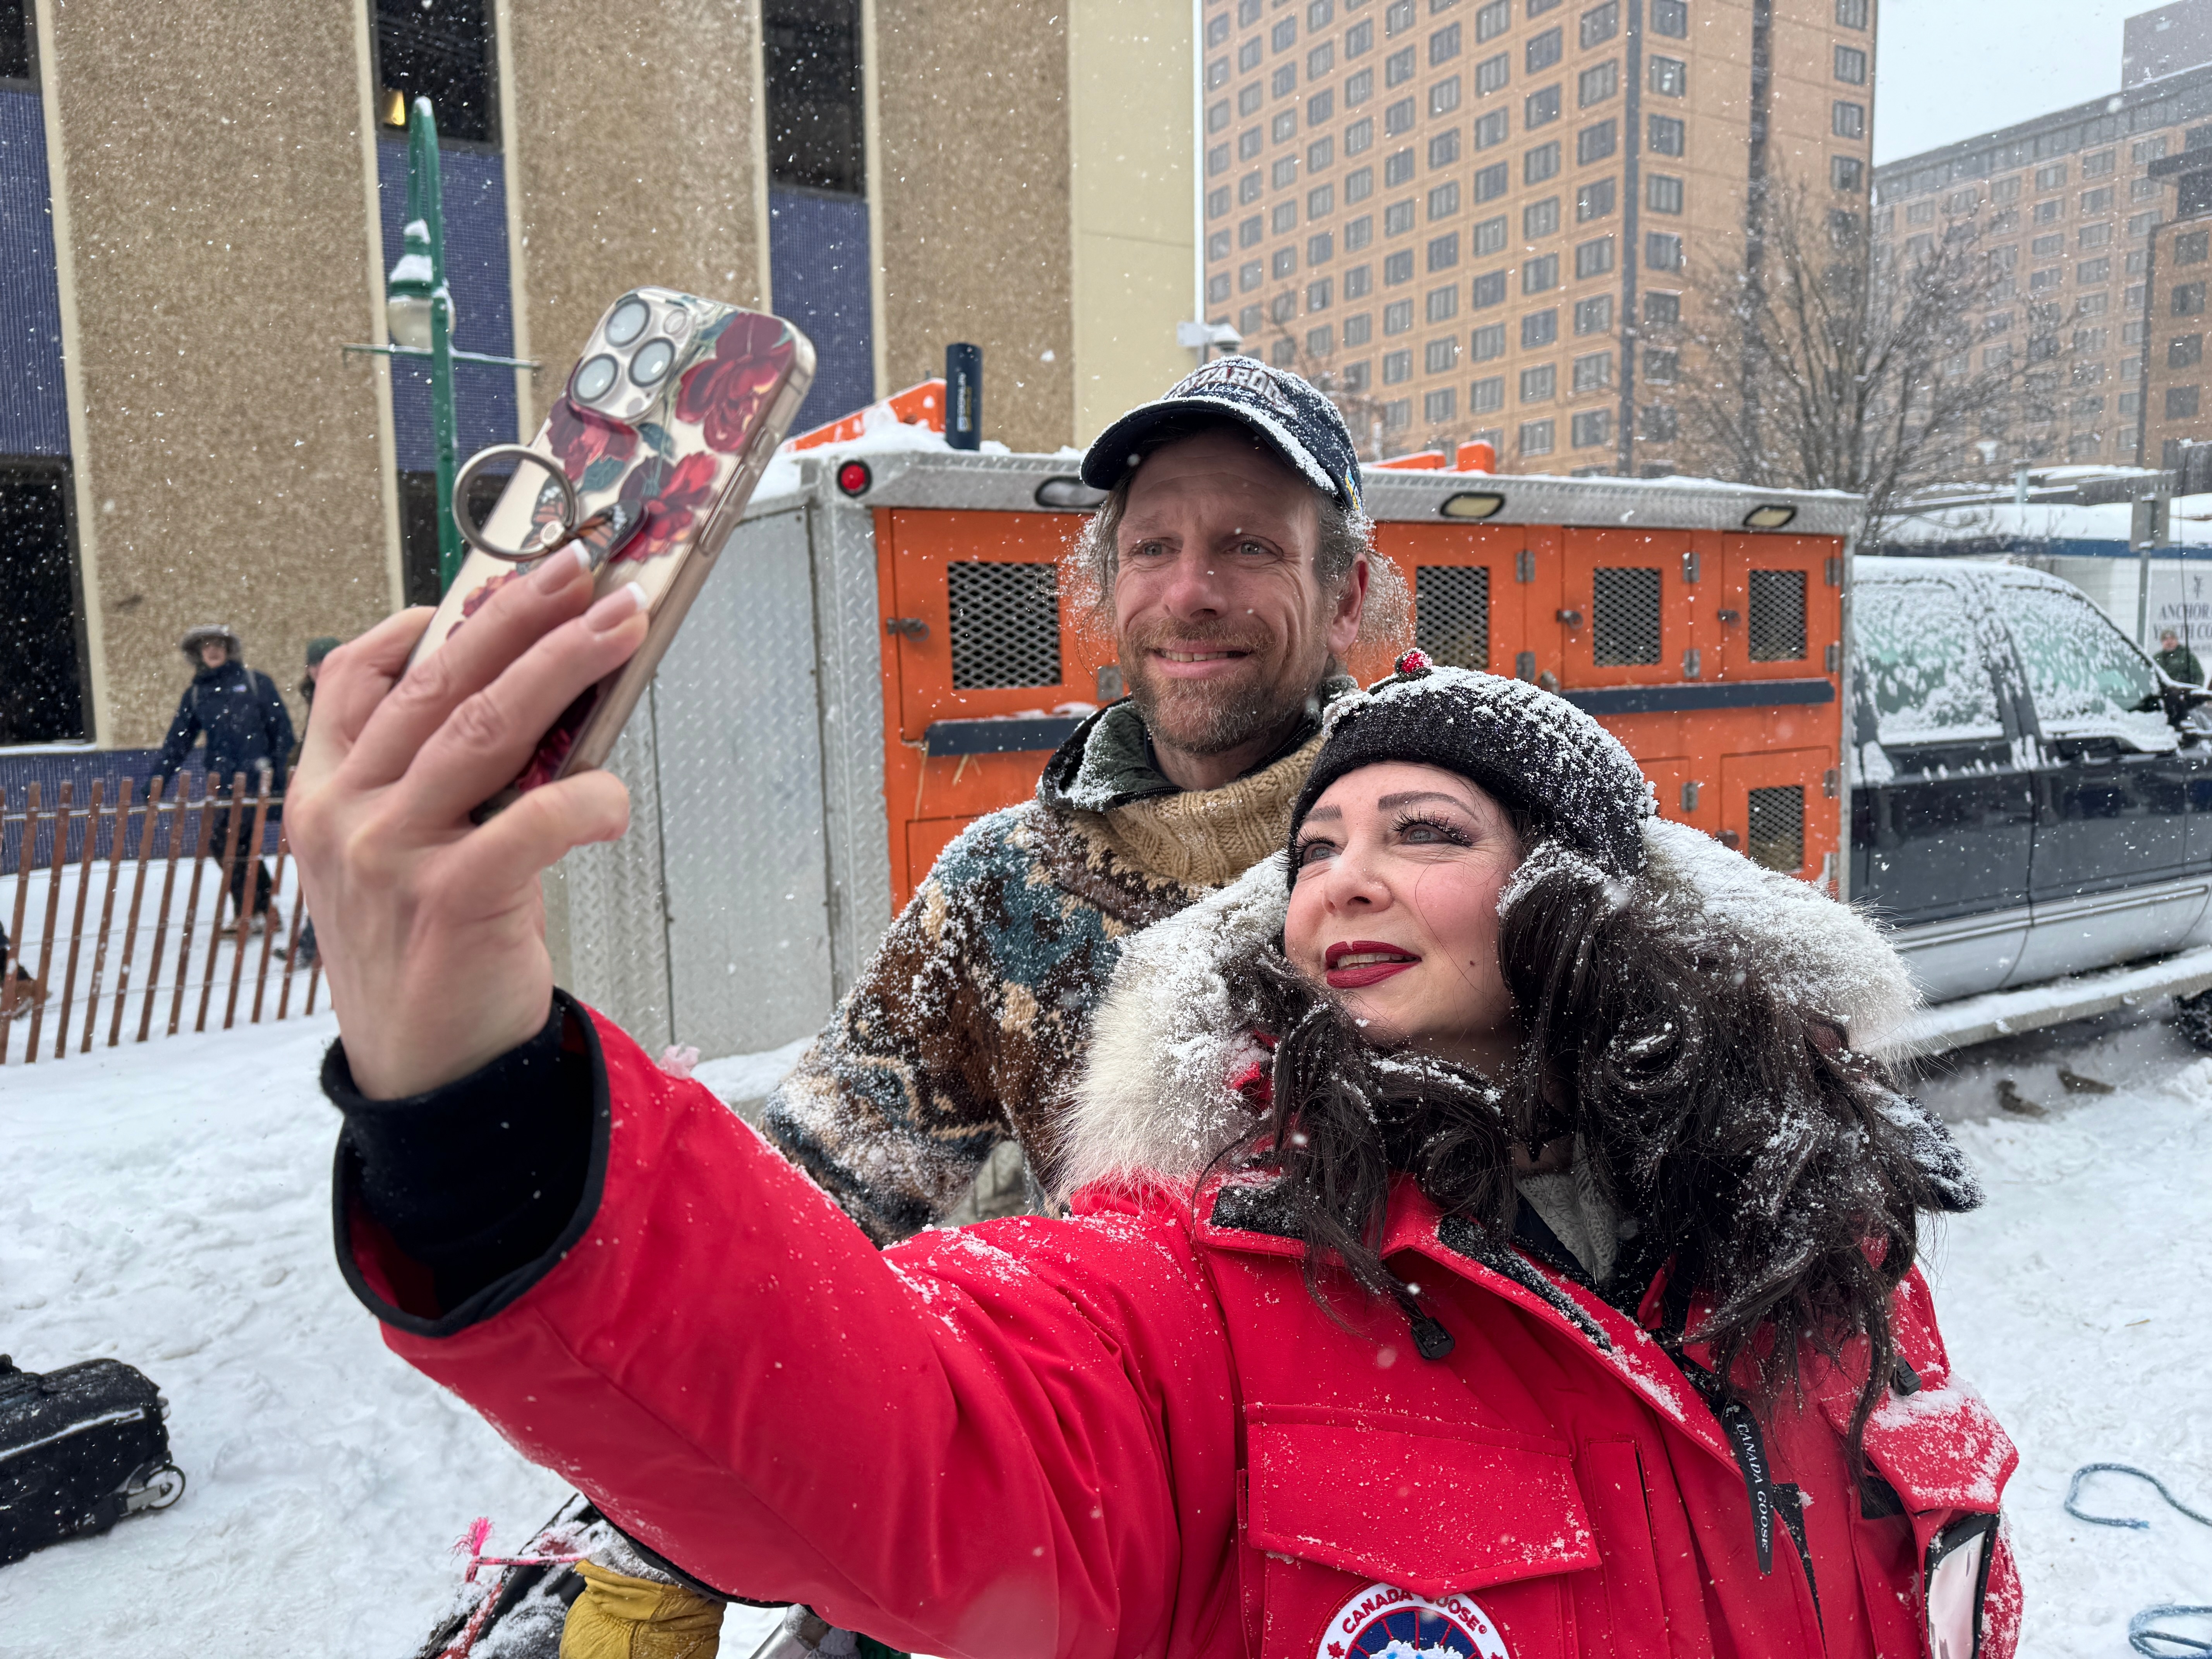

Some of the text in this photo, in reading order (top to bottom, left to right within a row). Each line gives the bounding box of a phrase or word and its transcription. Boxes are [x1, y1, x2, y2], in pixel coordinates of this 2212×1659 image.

[1194, 382, 1257, 398] Alaska
[2159, 603, 2212, 620] ANCHOR
[2153, 622, 2195, 641] YTH
[1737, 1424, 1769, 1553] CANADA GOOSE
[1343, 1589, 1414, 1634] CANADA
